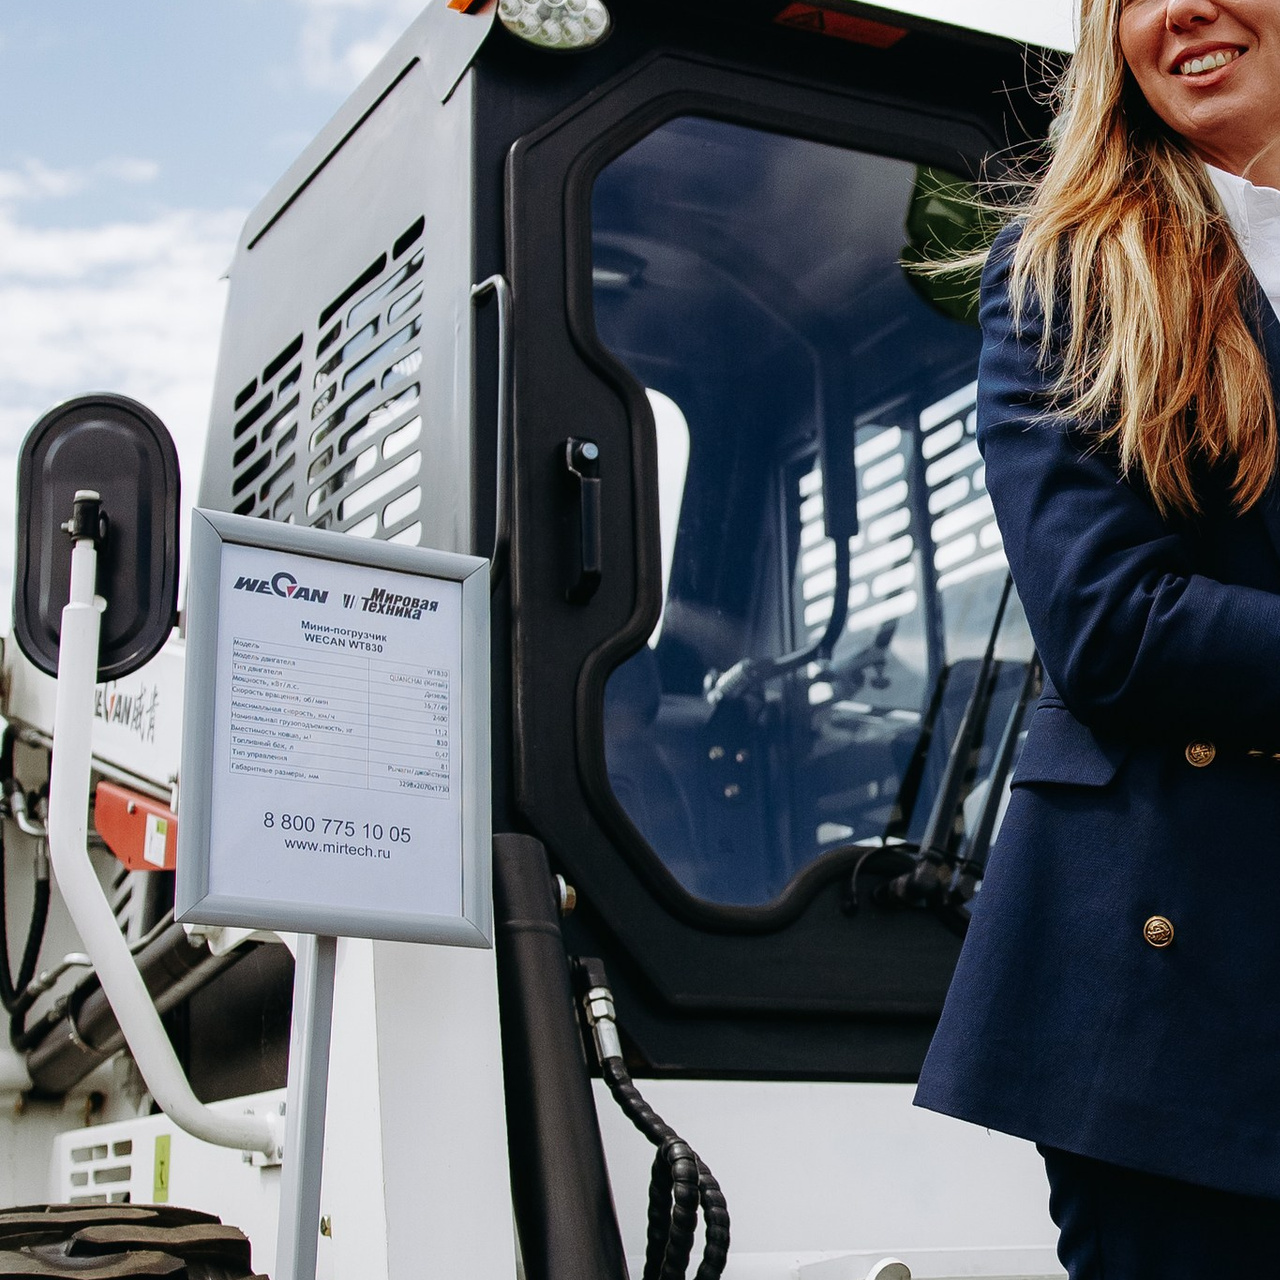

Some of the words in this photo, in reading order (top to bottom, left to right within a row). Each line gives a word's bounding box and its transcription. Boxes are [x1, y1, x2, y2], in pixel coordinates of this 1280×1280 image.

[233, 571, 329, 604] WECAN
[370, 587, 439, 612] Мировая
[361, 597, 422, 620] Техника
[301, 620, 387, 643] Мини-погрузчик
[233, 639, 260, 650] Модель
[304, 632, 346, 648] WECAN
[348, 640, 383, 654] WT830
[233, 650, 259, 662] Модель
[260, 655, 296, 666] двигателя
[233, 662, 247, 672] Тип
[247, 666, 283, 676] двигателя
[232, 686, 264, 698] Скорость
[231, 700, 282, 713] Максимальная
[231, 711, 278, 724] Номинальная
[231, 723, 276, 736] Вместимость
[232, 735, 272, 748] Топливный
[232, 748, 246, 757] Тип
[231, 762, 273, 775] Габаритные
[263, 811, 275, 828] 8
[281, 814, 315, 833] 800
[321, 818, 356, 837] 775
[362, 823, 384, 840] 10
[389, 826, 411, 844] 05
[284, 838, 391, 860] www.mirtech.ru
